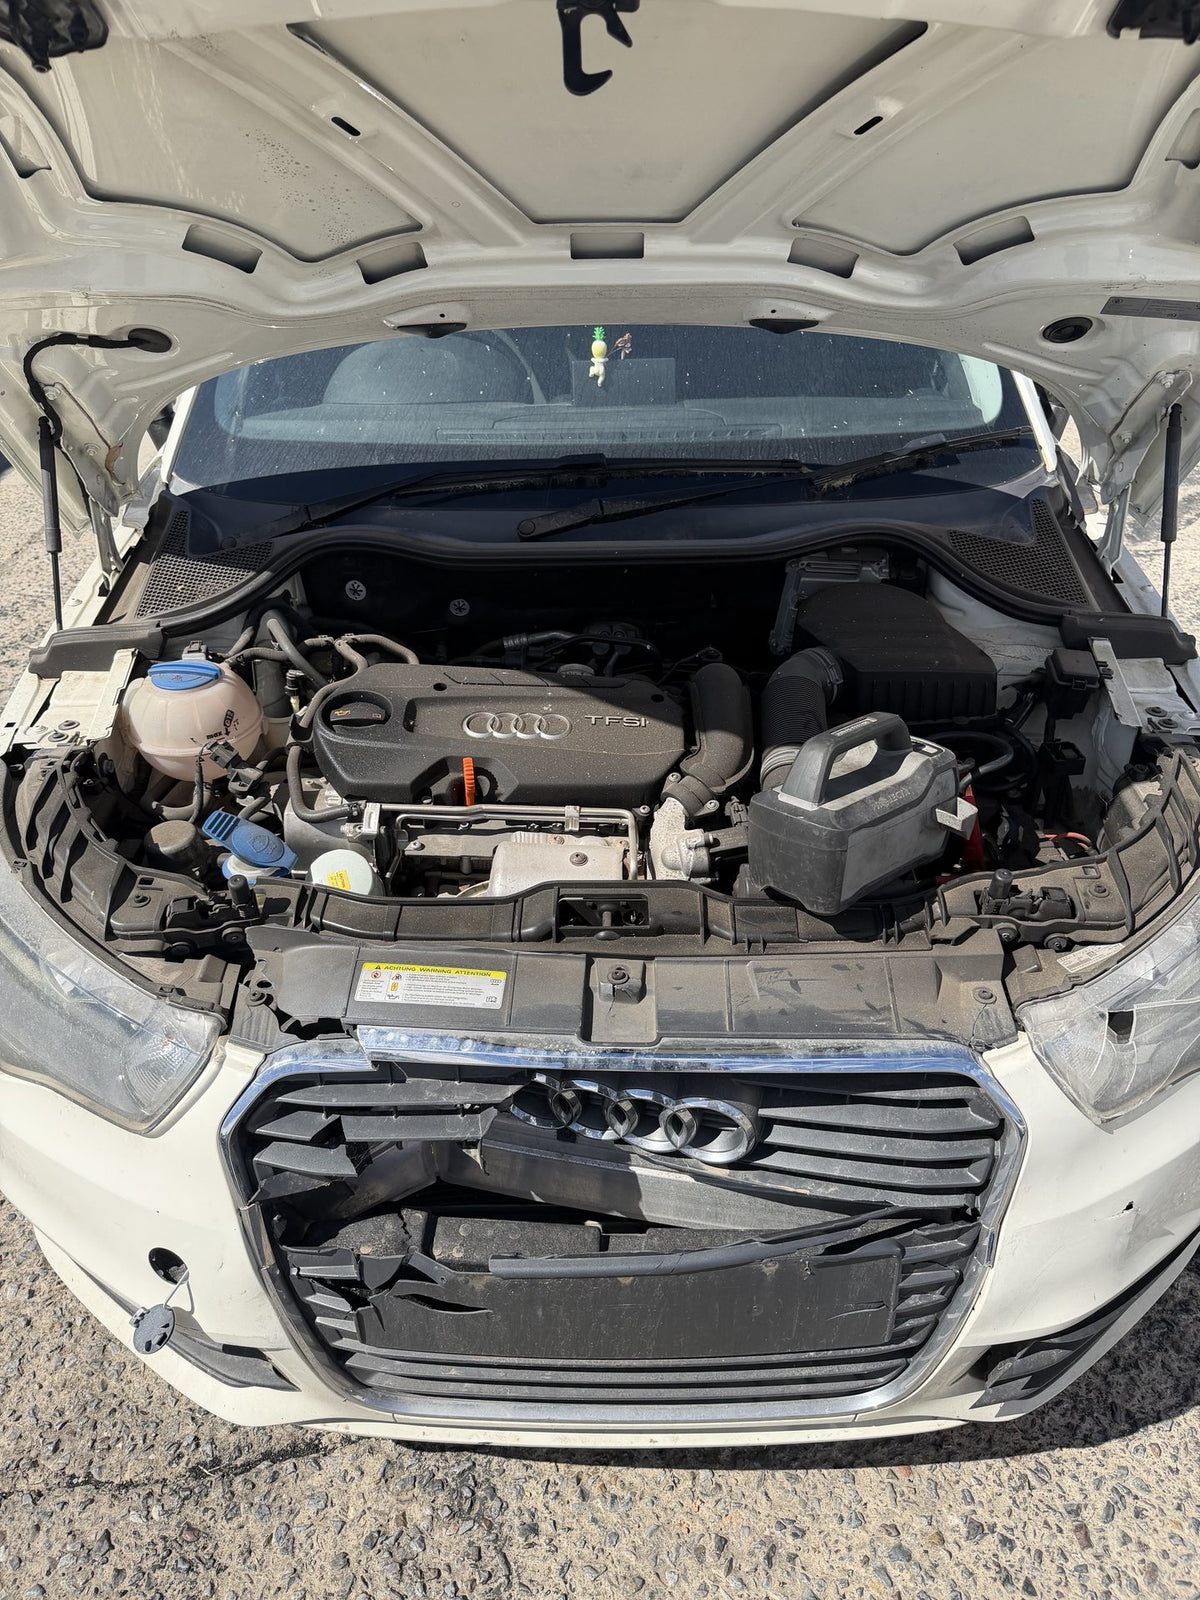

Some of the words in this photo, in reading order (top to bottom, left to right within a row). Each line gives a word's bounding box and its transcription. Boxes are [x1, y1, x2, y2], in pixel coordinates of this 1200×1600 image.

[584, 715, 646, 727] TFSI
[206, 731, 223, 739] max
[454, 969, 492, 977] ATTENTION
